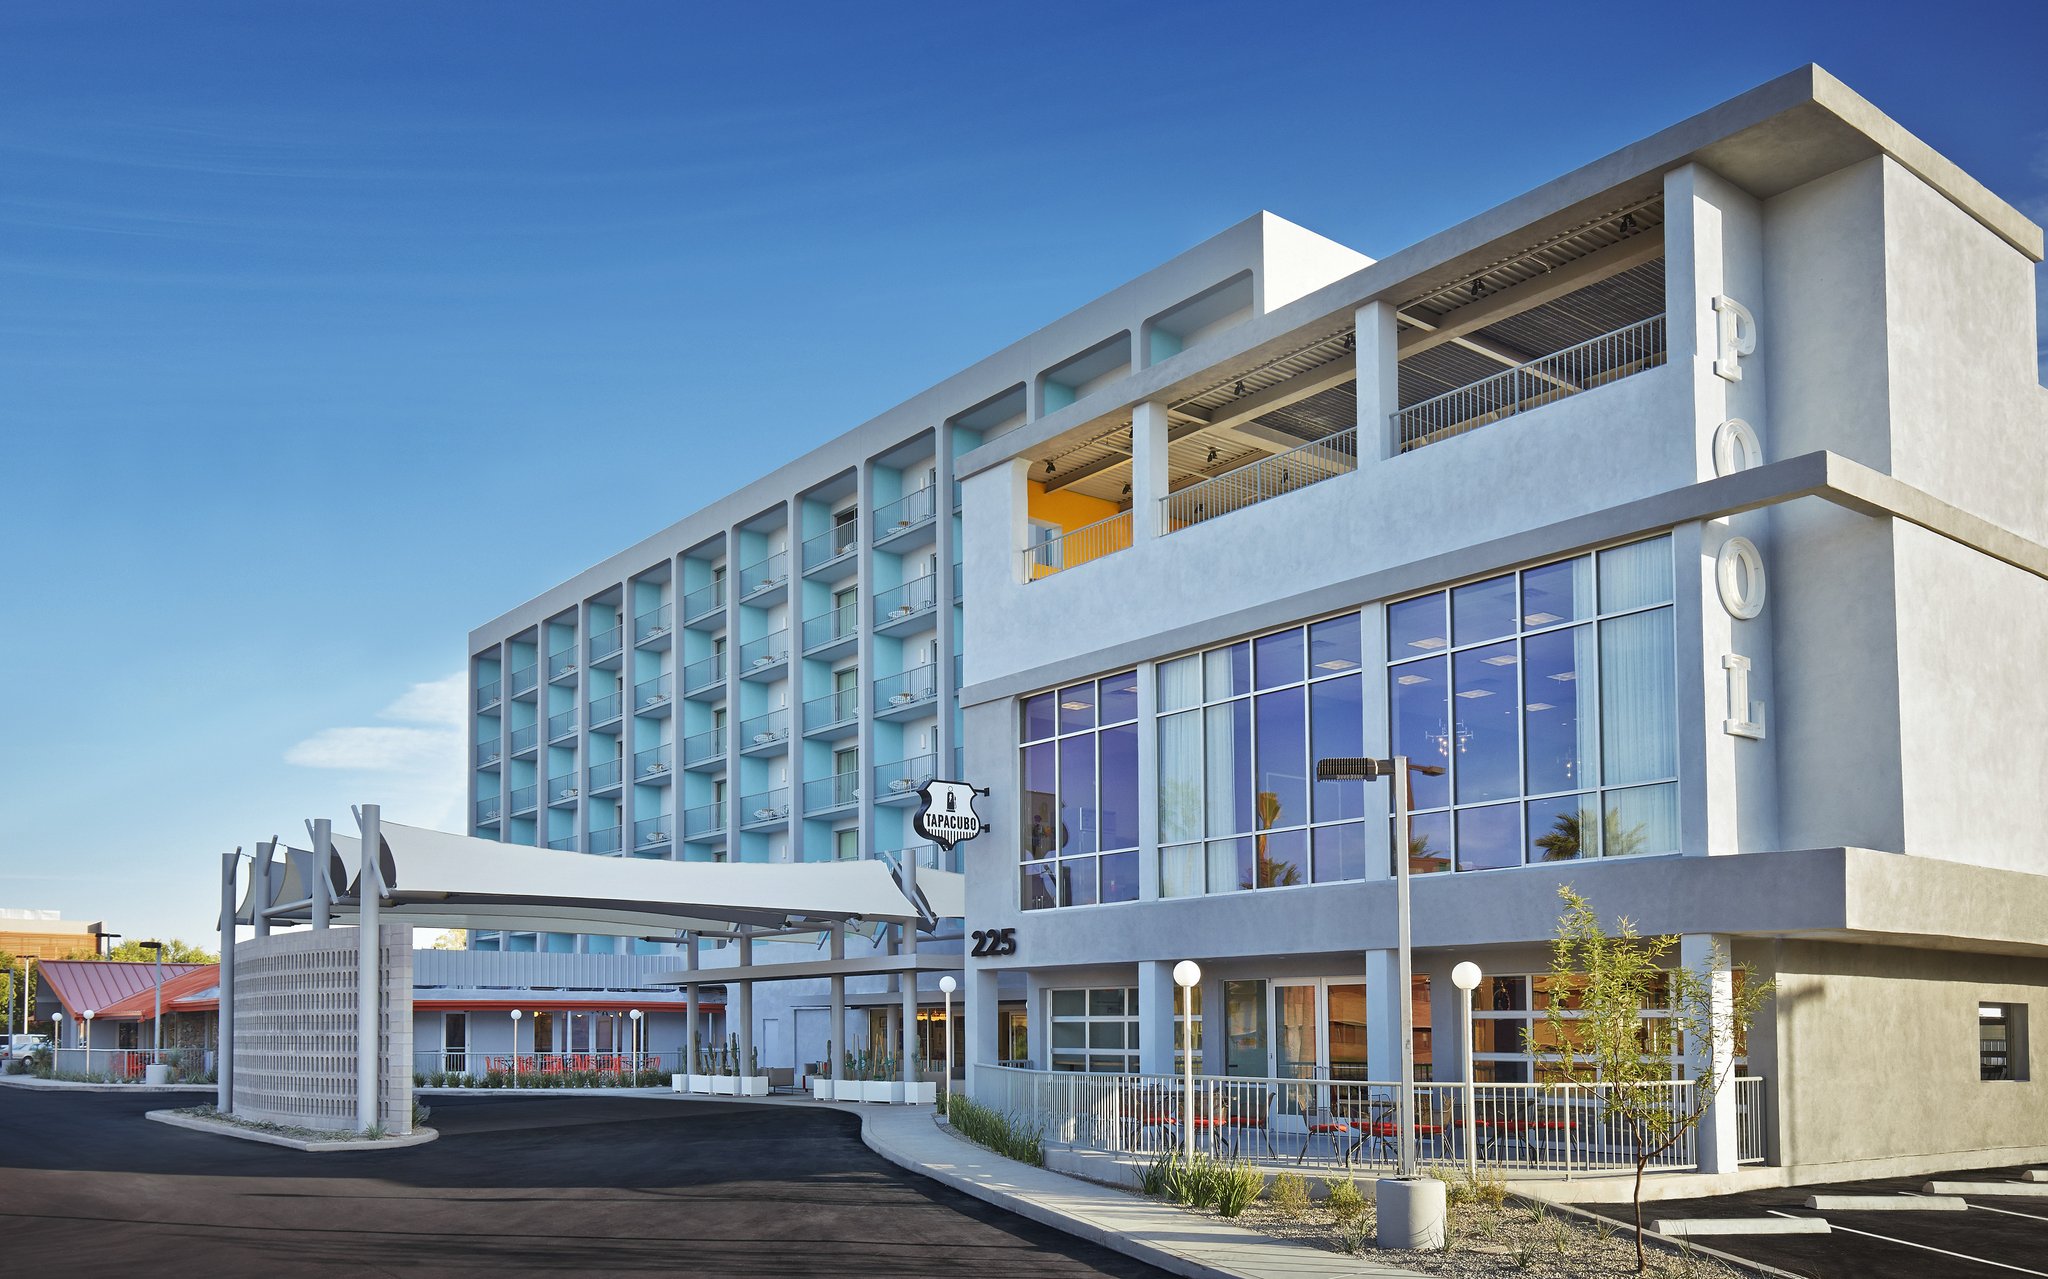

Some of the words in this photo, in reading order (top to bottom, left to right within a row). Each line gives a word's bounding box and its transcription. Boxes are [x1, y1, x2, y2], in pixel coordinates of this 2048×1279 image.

[1712, 295, 1766, 740] POOL
[926, 813, 977, 831] TAPACUBO
[971, 928, 1017, 957] 225
